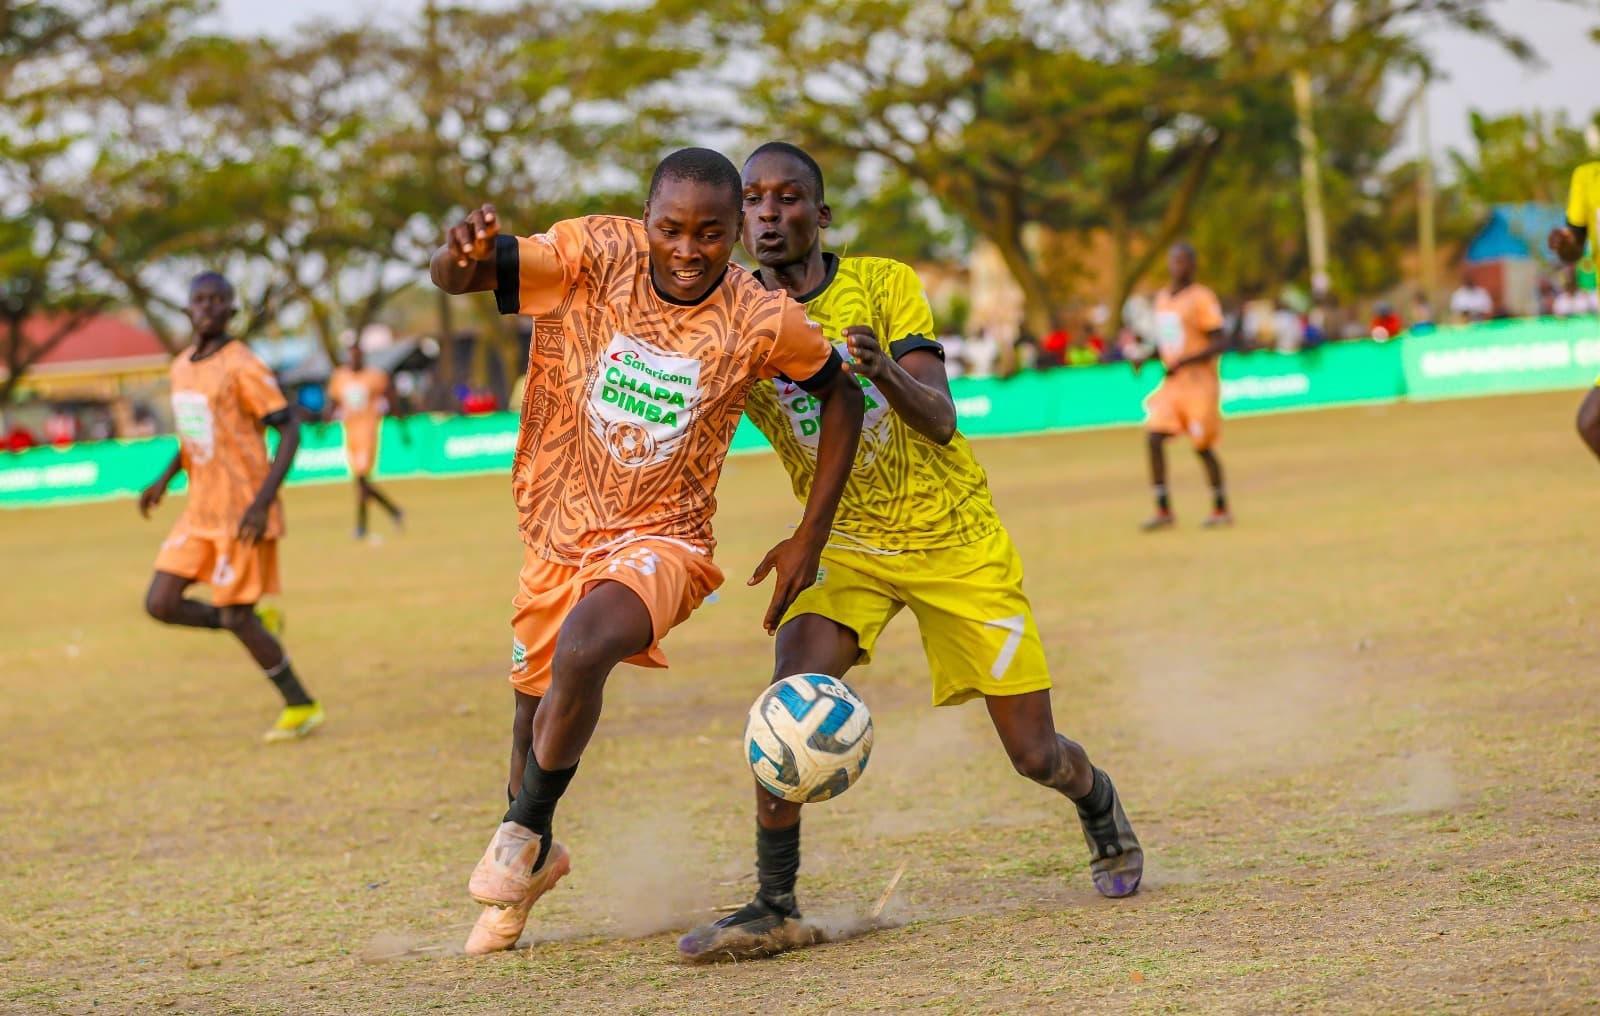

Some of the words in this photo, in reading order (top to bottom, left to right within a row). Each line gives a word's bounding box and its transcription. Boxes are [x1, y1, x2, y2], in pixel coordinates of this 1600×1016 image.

[601, 385, 678, 428] DIMBA
[605, 366, 686, 409] CHAPA
[983, 612, 1025, 681] 7
